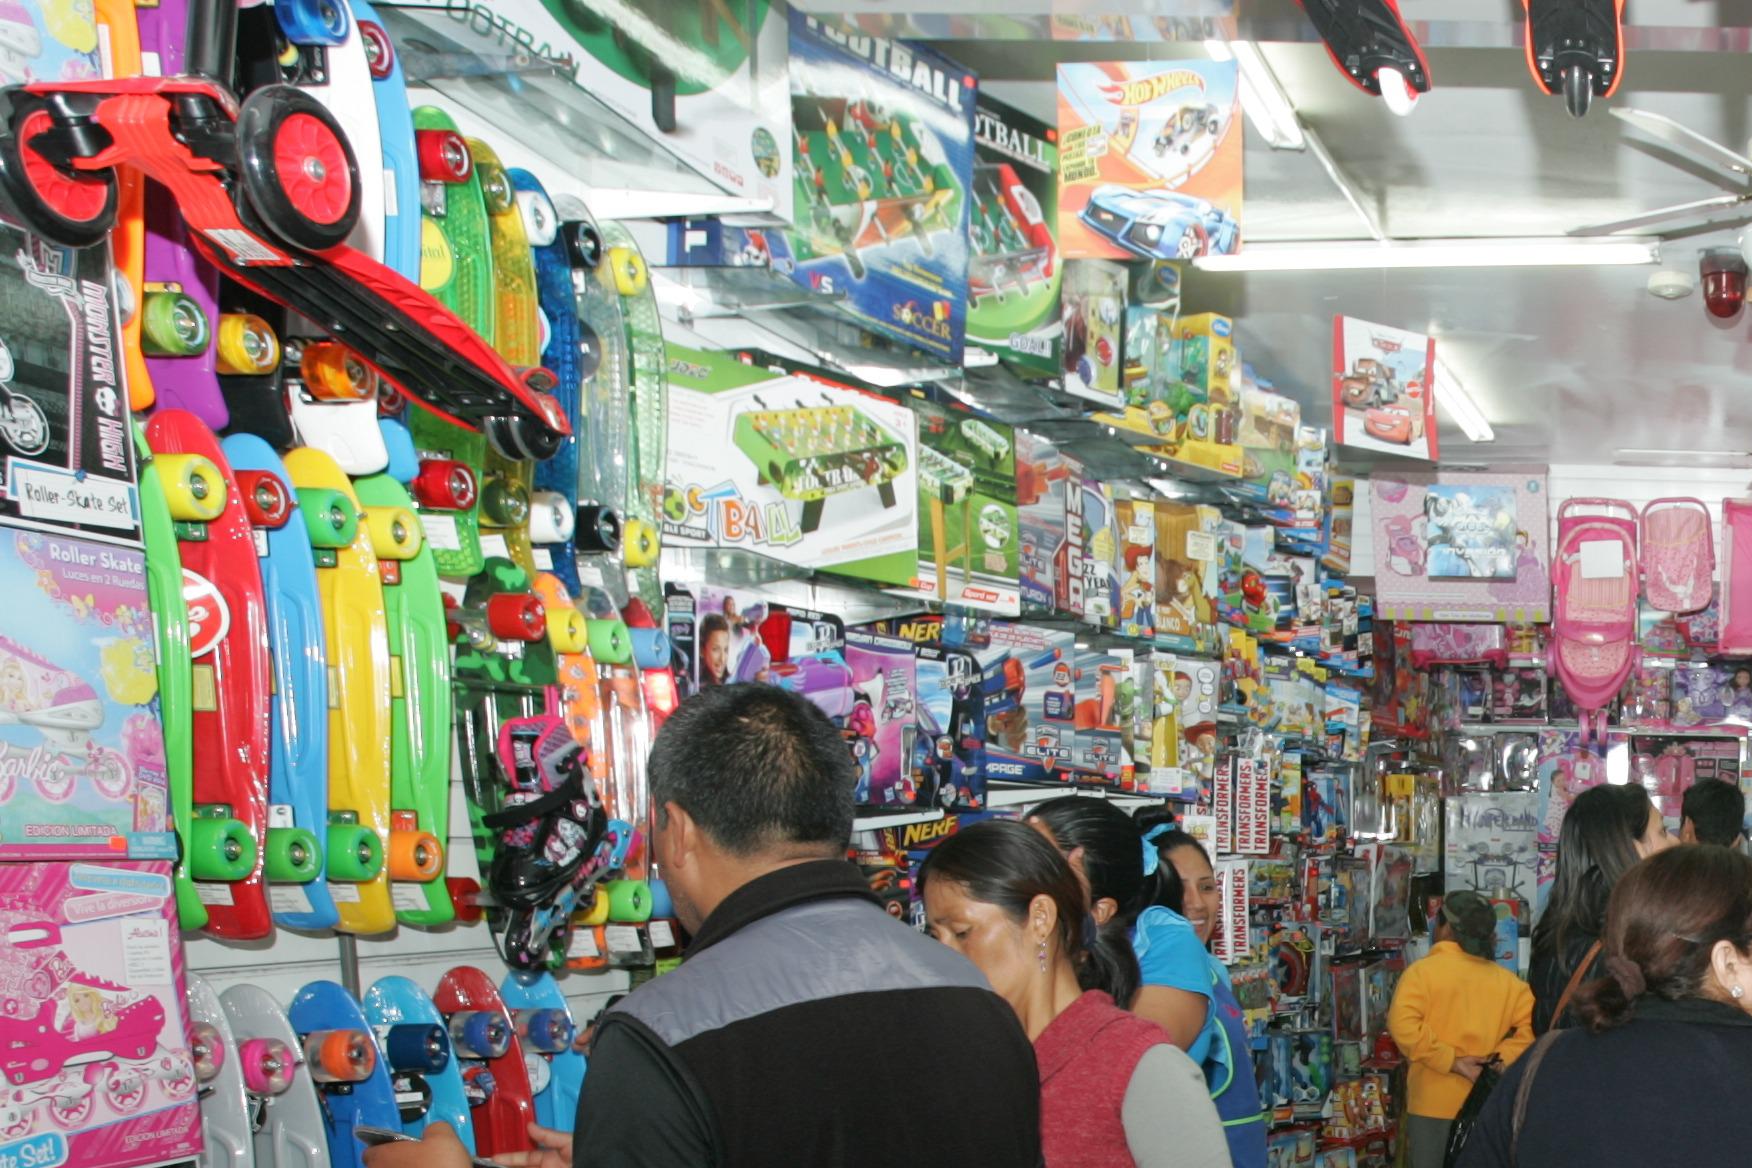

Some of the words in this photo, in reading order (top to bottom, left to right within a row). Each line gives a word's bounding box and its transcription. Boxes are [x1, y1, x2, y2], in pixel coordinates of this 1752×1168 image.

[82, 279, 116, 387] MONSTER
[97, 415, 127, 473] HIGH
[109, 496, 129, 516] Set
[49, 543, 97, 565] Roller
[98, 551, 144, 575] Skate
[61, 567, 90, 583] Luces
[90, 573, 103, 585] en
[899, 622, 941, 642] NER
[1026, 746, 1069, 758] ELITE
[1238, 761, 1252, 851] TRANSFORMERS
[25, 824, 71, 838] EDICION
[904, 816, 957, 847] NERF
[1232, 868, 1245, 954] TRANSFORMERS
[20, 1137, 57, 1168] Set!
